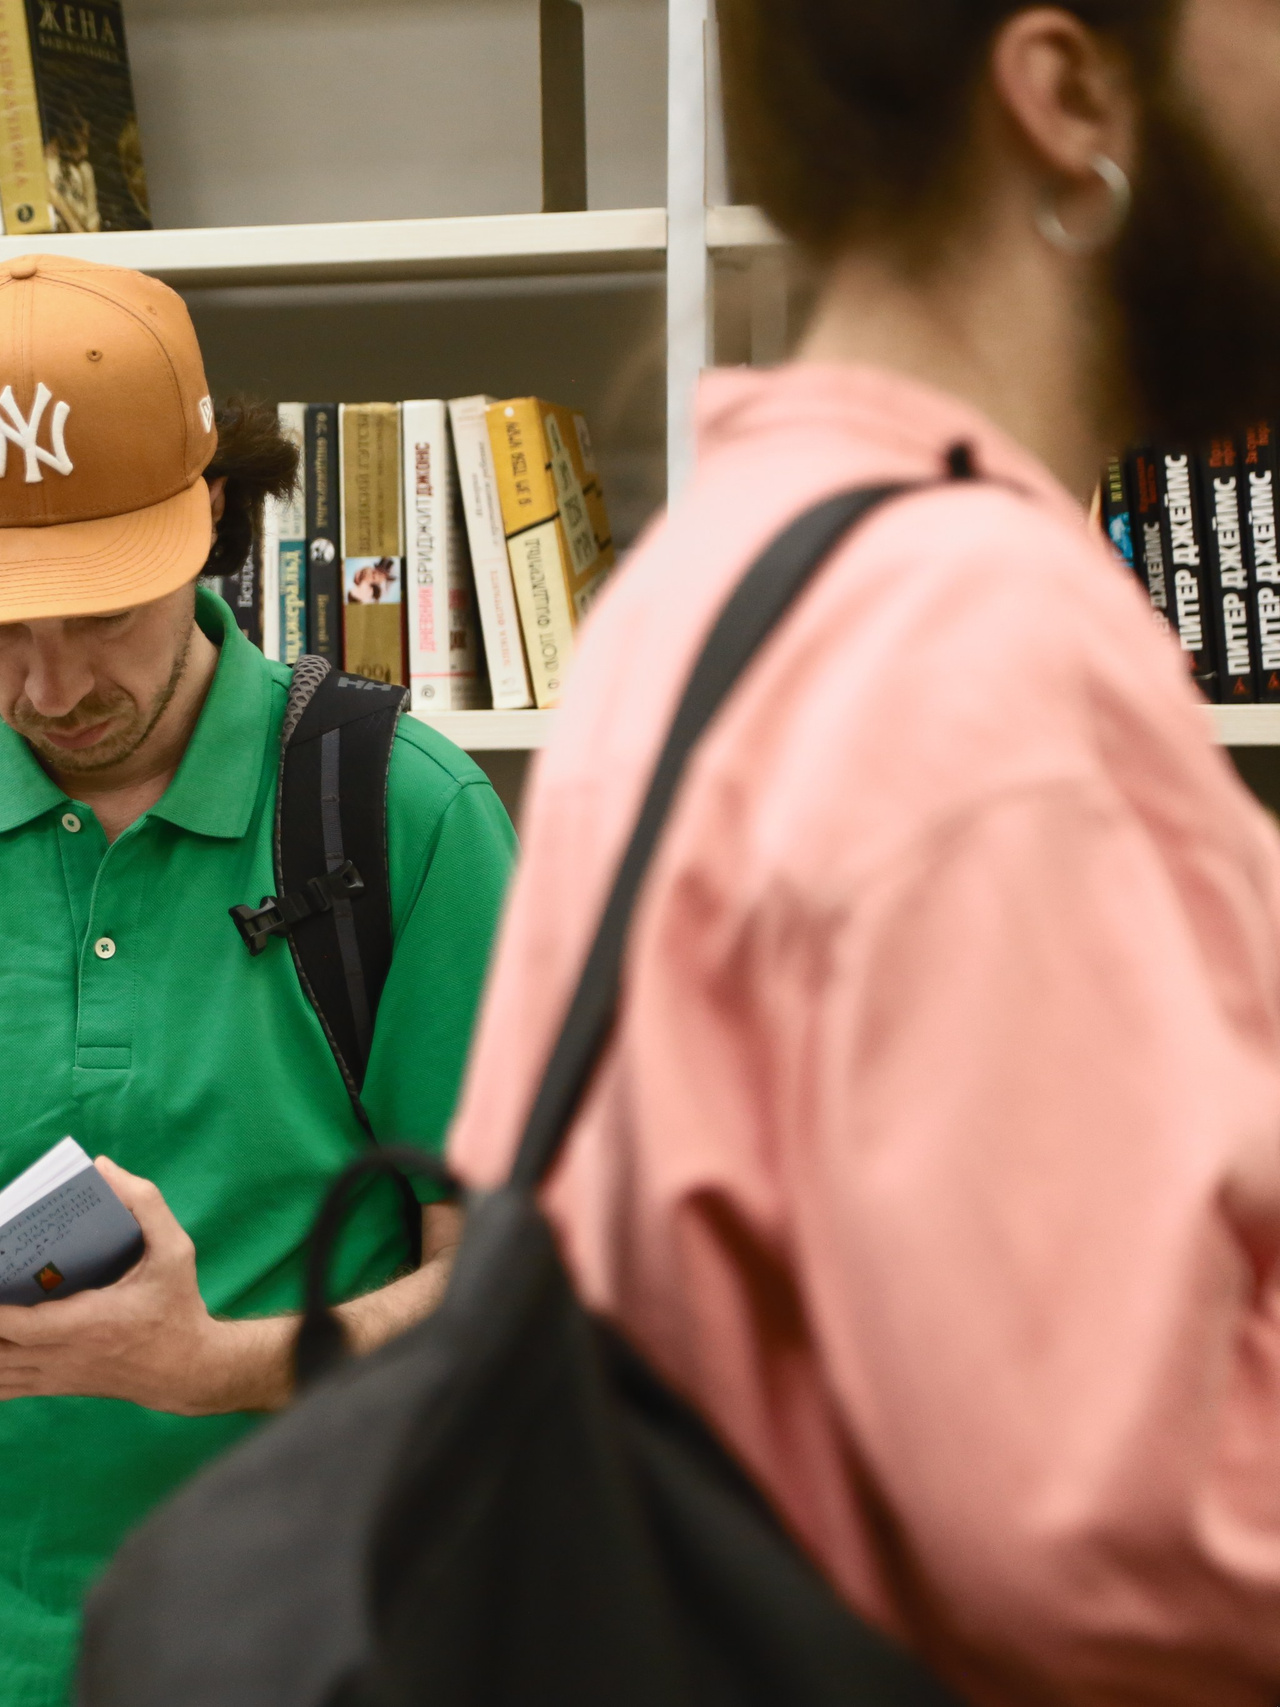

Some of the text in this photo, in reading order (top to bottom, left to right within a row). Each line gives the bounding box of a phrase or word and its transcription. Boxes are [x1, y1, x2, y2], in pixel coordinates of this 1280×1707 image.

[38, 0, 117, 47] ЖЕНА
[416, 442, 436, 652] ДНЕВНИК БРИДЖИТ ДЖОНС
[1143, 521, 1168, 609] ДЖЕЙМС
[1164, 454, 1203, 651] ПИТЕР ДЖЕЙМС
[1212, 476, 1249, 590] ДЖЕЙМС
[1248, 470, 1280, 584] ДЖЕЙМС
[284, 551, 305, 664] цджеральд
[1222, 592, 1251, 676] ПИТЕР
[1257, 587, 1280, 670] ПИТЕР
